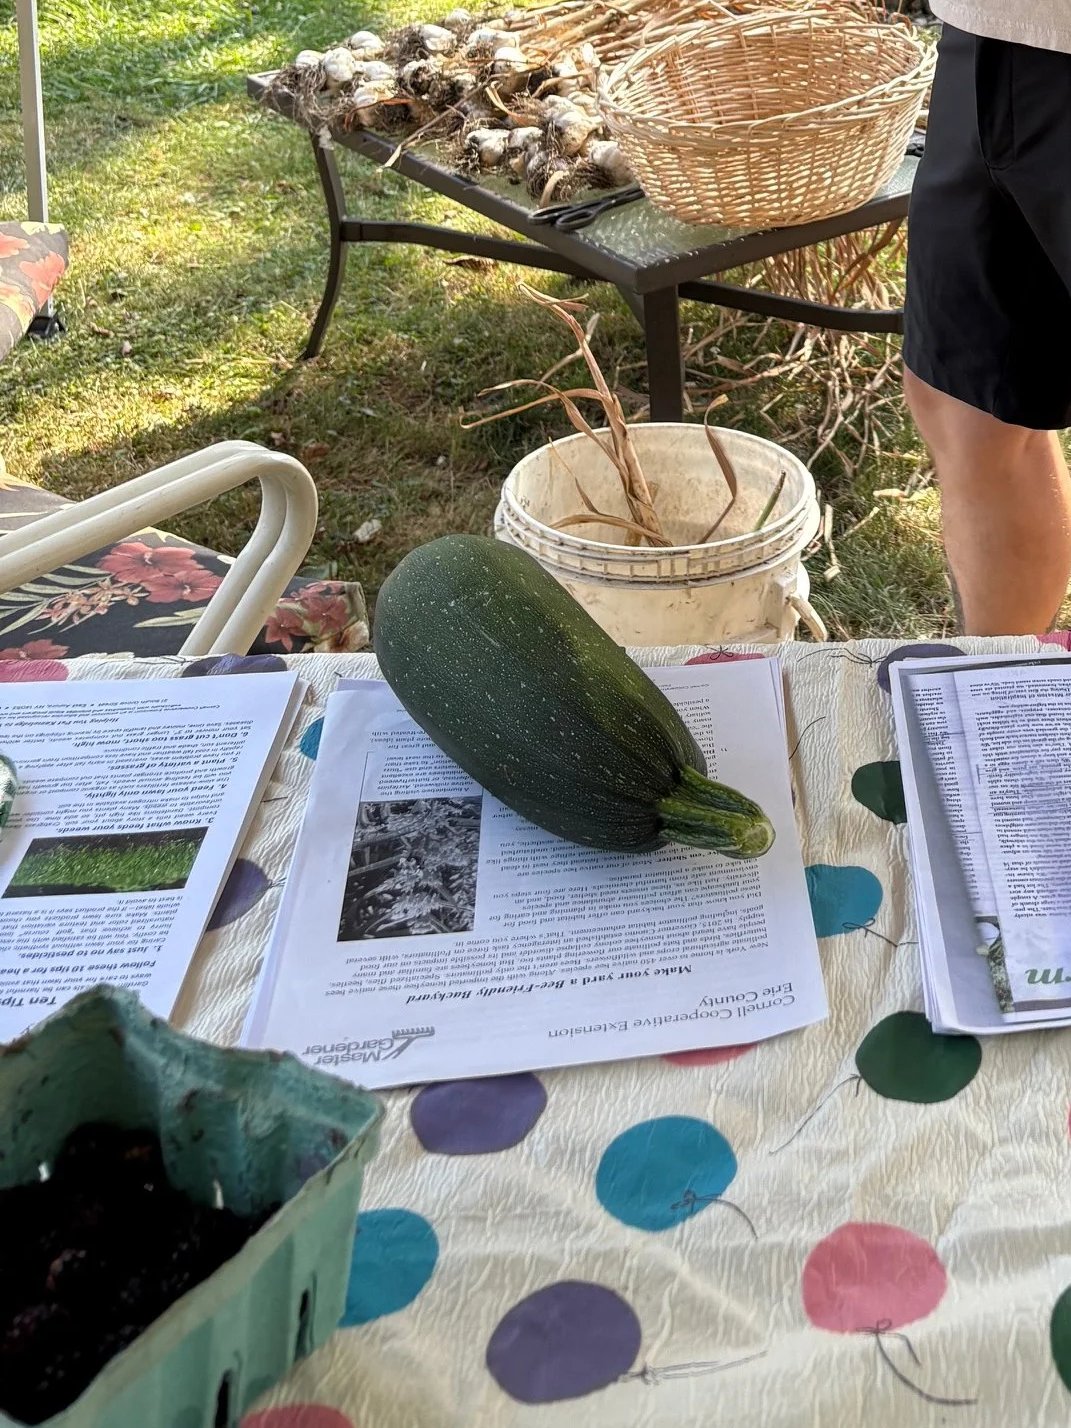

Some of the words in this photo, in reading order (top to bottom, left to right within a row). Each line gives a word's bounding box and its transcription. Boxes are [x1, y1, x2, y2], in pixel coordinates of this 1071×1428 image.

[169, 734, 194, 742] grass
[195, 734, 210, 742] cut
[212, 732, 237, 741] Don't
[72, 741, 95, 750] high.
[123, 738, 149, 746] short,
[108, 762, 145, 771] grasses.
[158, 761, 191, 769] variety
[201, 758, 225, 766] Plant
[166, 785, 189, 794] your
[190, 785, 214, 794] Feed
[84, 791, 117, 801] lightly.
[118, 790, 140, 799] only
[92, 823, 115, 832] your
[117, 823, 144, 832] feeds
[146, 821, 171, 829] what
[56, 826, 90, 835] weeds.
[732, 932, 767, 945] pollinate
[683, 940, 729, 953] agricultural
[726, 945, 746, 954] York
[750, 941, 768, 949] New
[19, 949, 75, 960] pesticides.
[127, 946, 149, 954] Just
[640, 949, 654, 958] and
[657, 946, 679, 954] crops
[691, 949, 713, 957] home
[586, 952, 636, 962] wildflowers.
[641, 957, 656, 966] 450
[120, 960, 156, 969] Follow
[533, 961, 557, 971] aren't
[561, 958, 581, 966] Bees
[595, 962, 609, 970] bee
[612, 959, 638, 968] native
[50, 964, 70, 973] tips
[88, 963, 118, 971] these
[495, 966, 514, 975] only
[518, 965, 530, 973] the
[560, 963, 592, 973] species.
[654, 964, 691, 976] Make
[446, 967, 492, 979] pollinators.
[507, 972, 526, 981] with
[529, 968, 556, 977] Along
[618, 968, 649, 979] your
[391, 974, 440, 985] Specialized
[449, 976, 488, 987] imported
[583, 972, 613, 986] yard
[329, 981, 362, 989] beetles,
[379, 984, 401, 992] these
[404, 980, 446, 990] honeybee
[477, 980, 564, 997] Bee-Friendly
[762, 982, 793, 997] Erie
[348, 987, 375, 995] native
[29, 996, 58, 1006] Ten
[407, 990, 472, 1005] Backyard
[698, 989, 757, 1006] County
[738, 994, 795, 1018] Cornell
[633, 1008, 732, 1029] Cooperative
[548, 1020, 628, 1039] Extension
[302, 1038, 395, 1056] Gardener
[314, 1051, 383, 1065] Master
